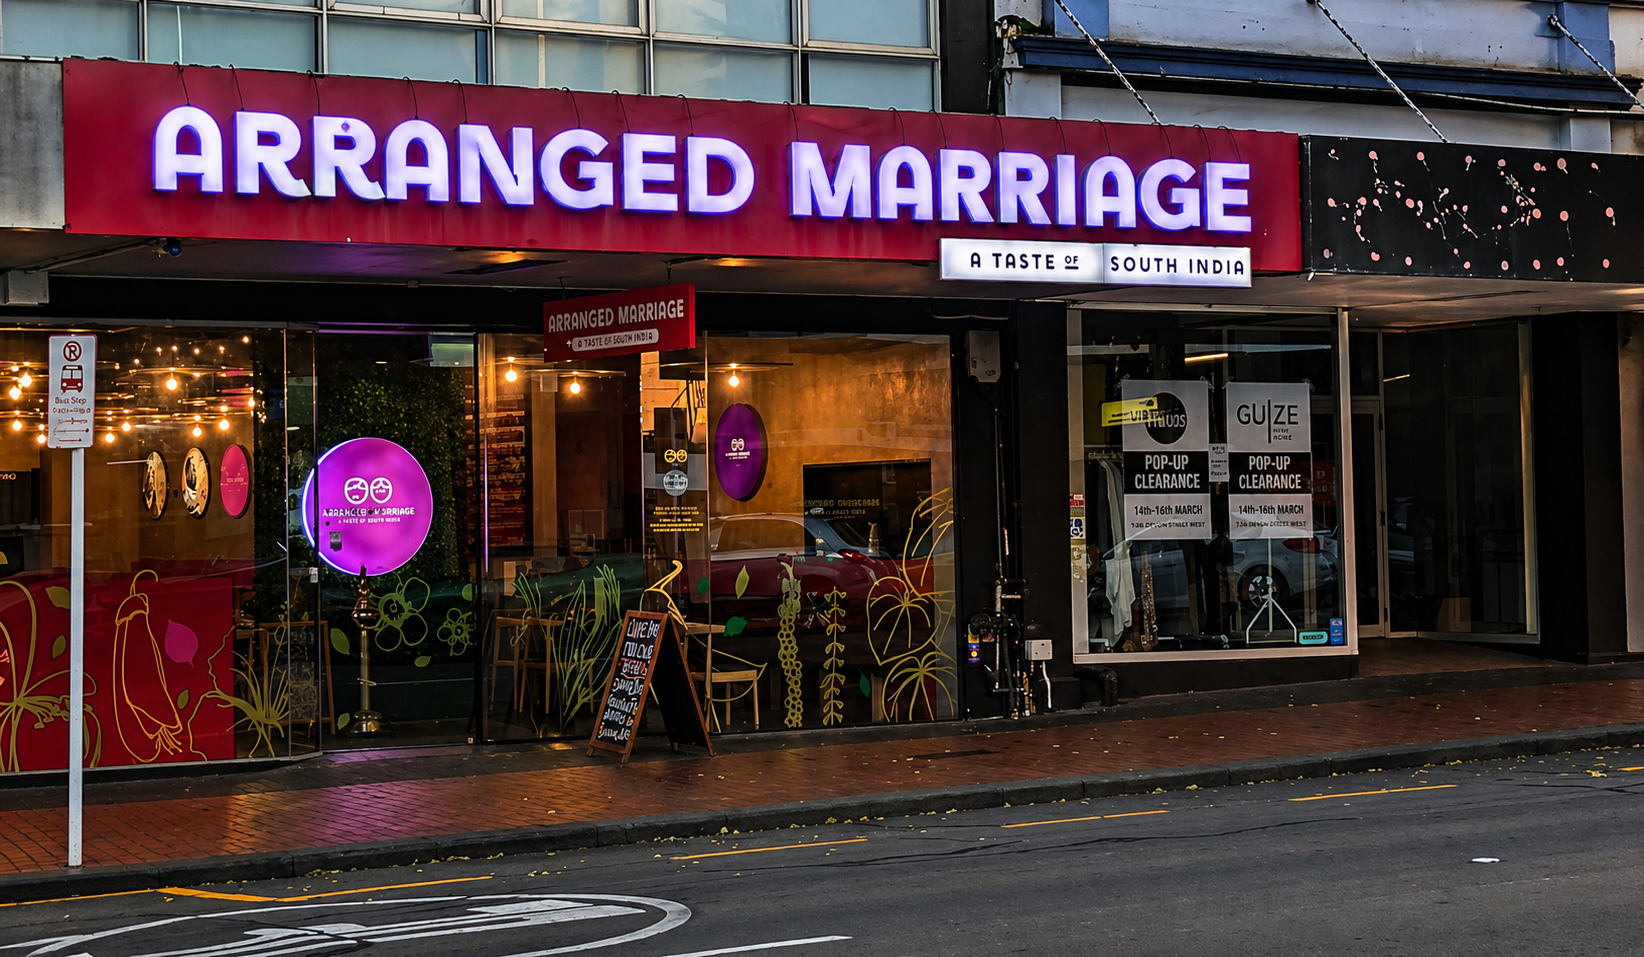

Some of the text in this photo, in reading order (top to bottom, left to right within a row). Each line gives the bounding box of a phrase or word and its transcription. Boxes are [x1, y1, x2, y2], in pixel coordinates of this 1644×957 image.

[152, 104, 1252, 233] ARRANGED MARRIAGE
[970, 252, 1245, 275] A TASTE OF SOUTH INDIA
[548, 298, 684, 334] ARRANGED MARRIAGE
[584, 336, 603, 347] TASTE
[1145, 454, 1189, 470] POP-UP
[1249, 455, 1291, 471] POP-UP
[1134, 473, 1200, 489] CLEARANCE
[1239, 474, 1302, 489] CLEARANCE
[1134, 504, 1203, 516] 14th-16th MARCH
[1239, 504, 1304, 514] 14th-16th MARCH
